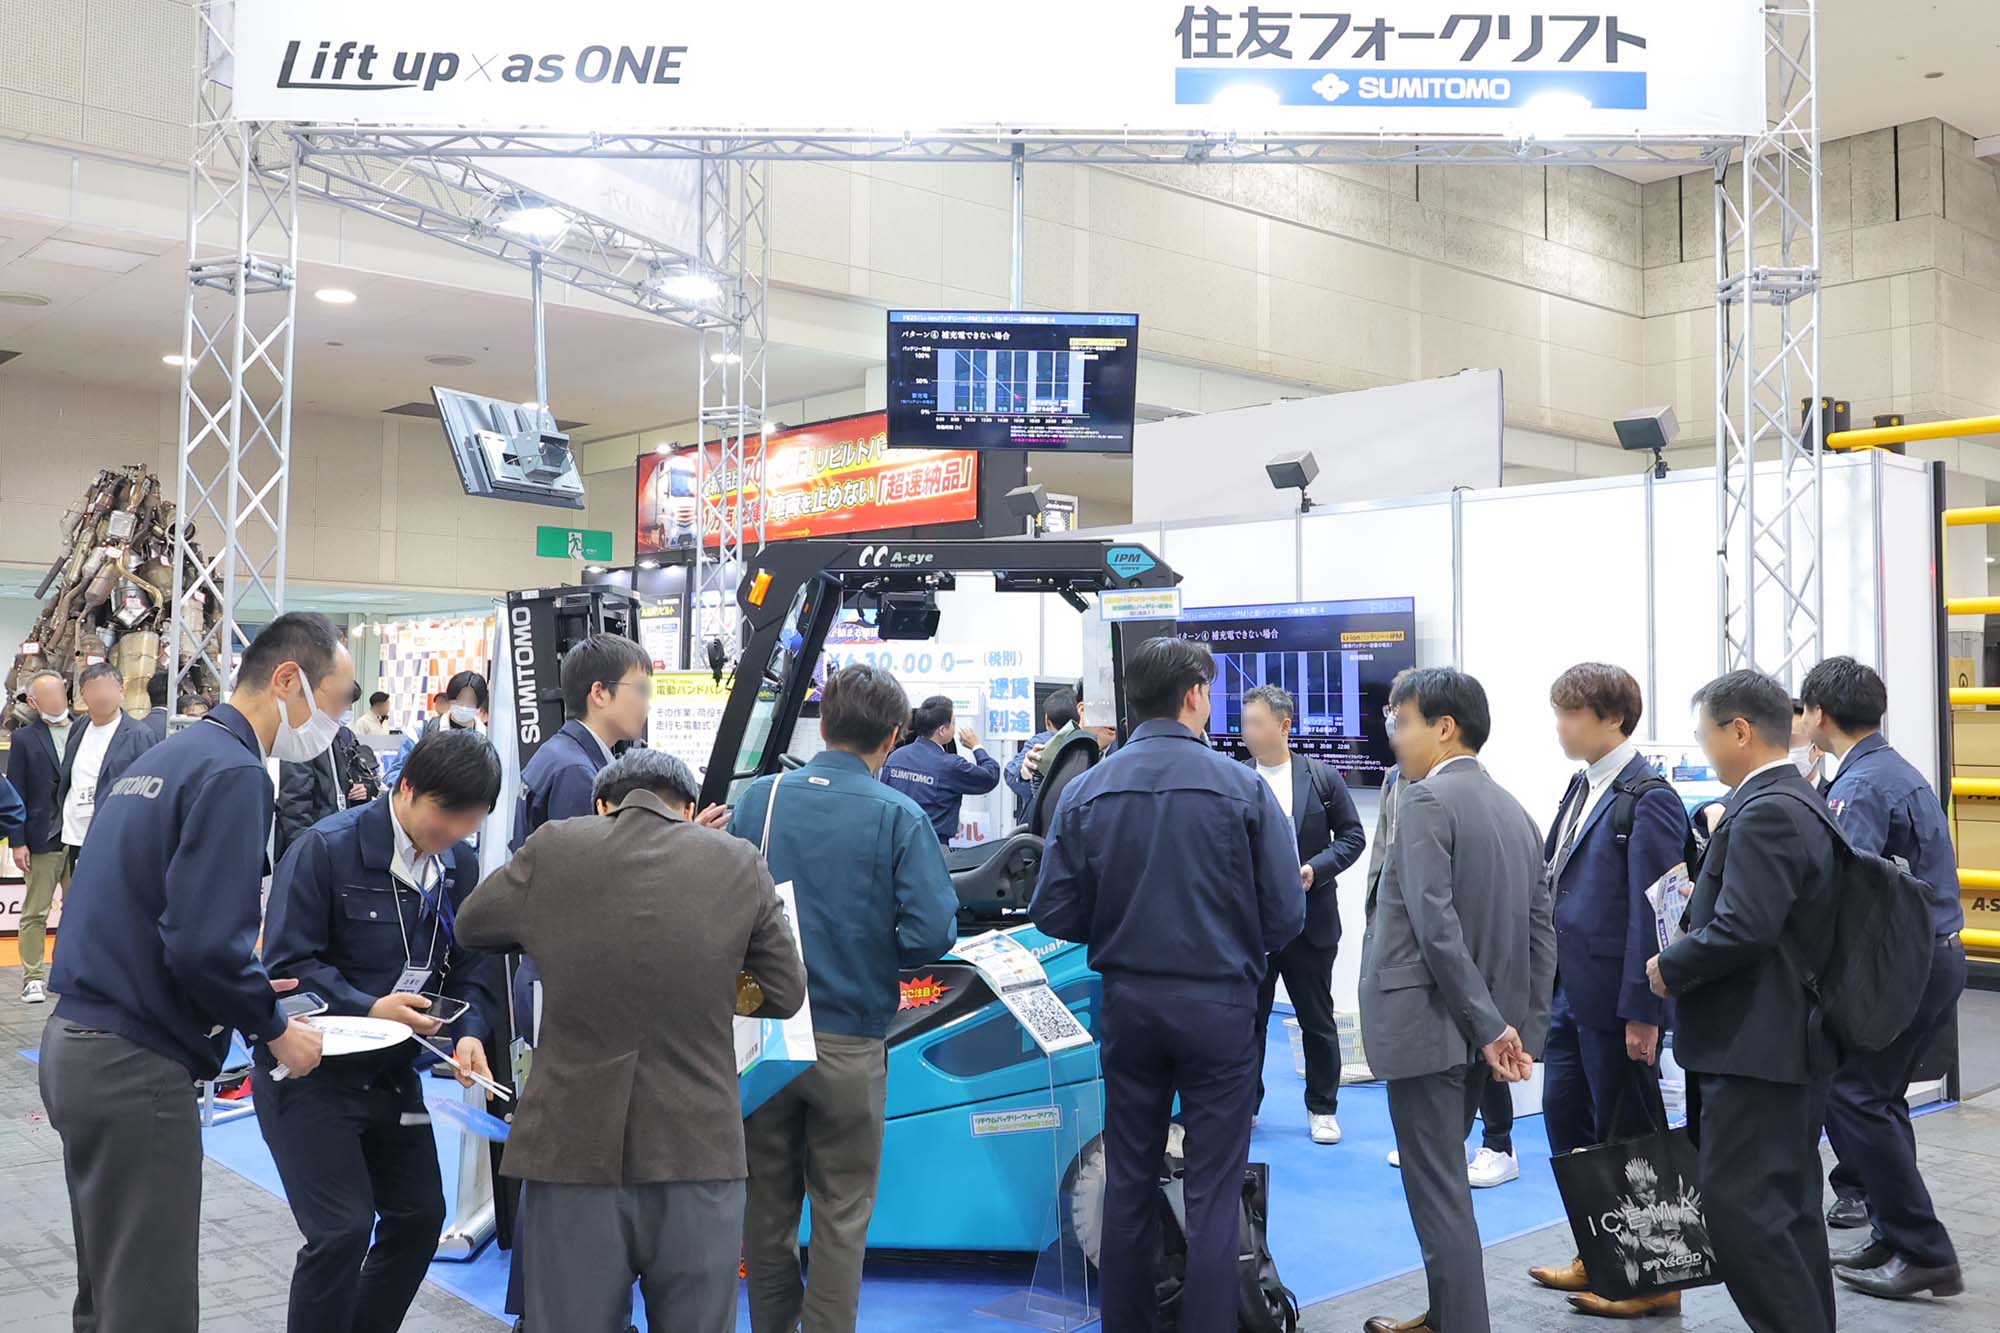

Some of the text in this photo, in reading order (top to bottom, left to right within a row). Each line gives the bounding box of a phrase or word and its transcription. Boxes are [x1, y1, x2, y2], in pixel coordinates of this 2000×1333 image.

[1174, 5, 1647, 64] 住友フォークリフト
[276, 40, 378, 88] Lift
[392, 51, 460, 91] up
[501, 51, 565, 84] as
[574, 45, 688, 85] ONE
[1358, 77, 1511, 101] SUMITOMO
[890, 551, 934, 565] A-eye
[1114, 553, 1142, 563] IPM
[1211, 628, 1279, 641] 補充電できない場合
[511, 606, 541, 745] SUMITOMO
[890, 768, 935, 786] SUMITOMO
